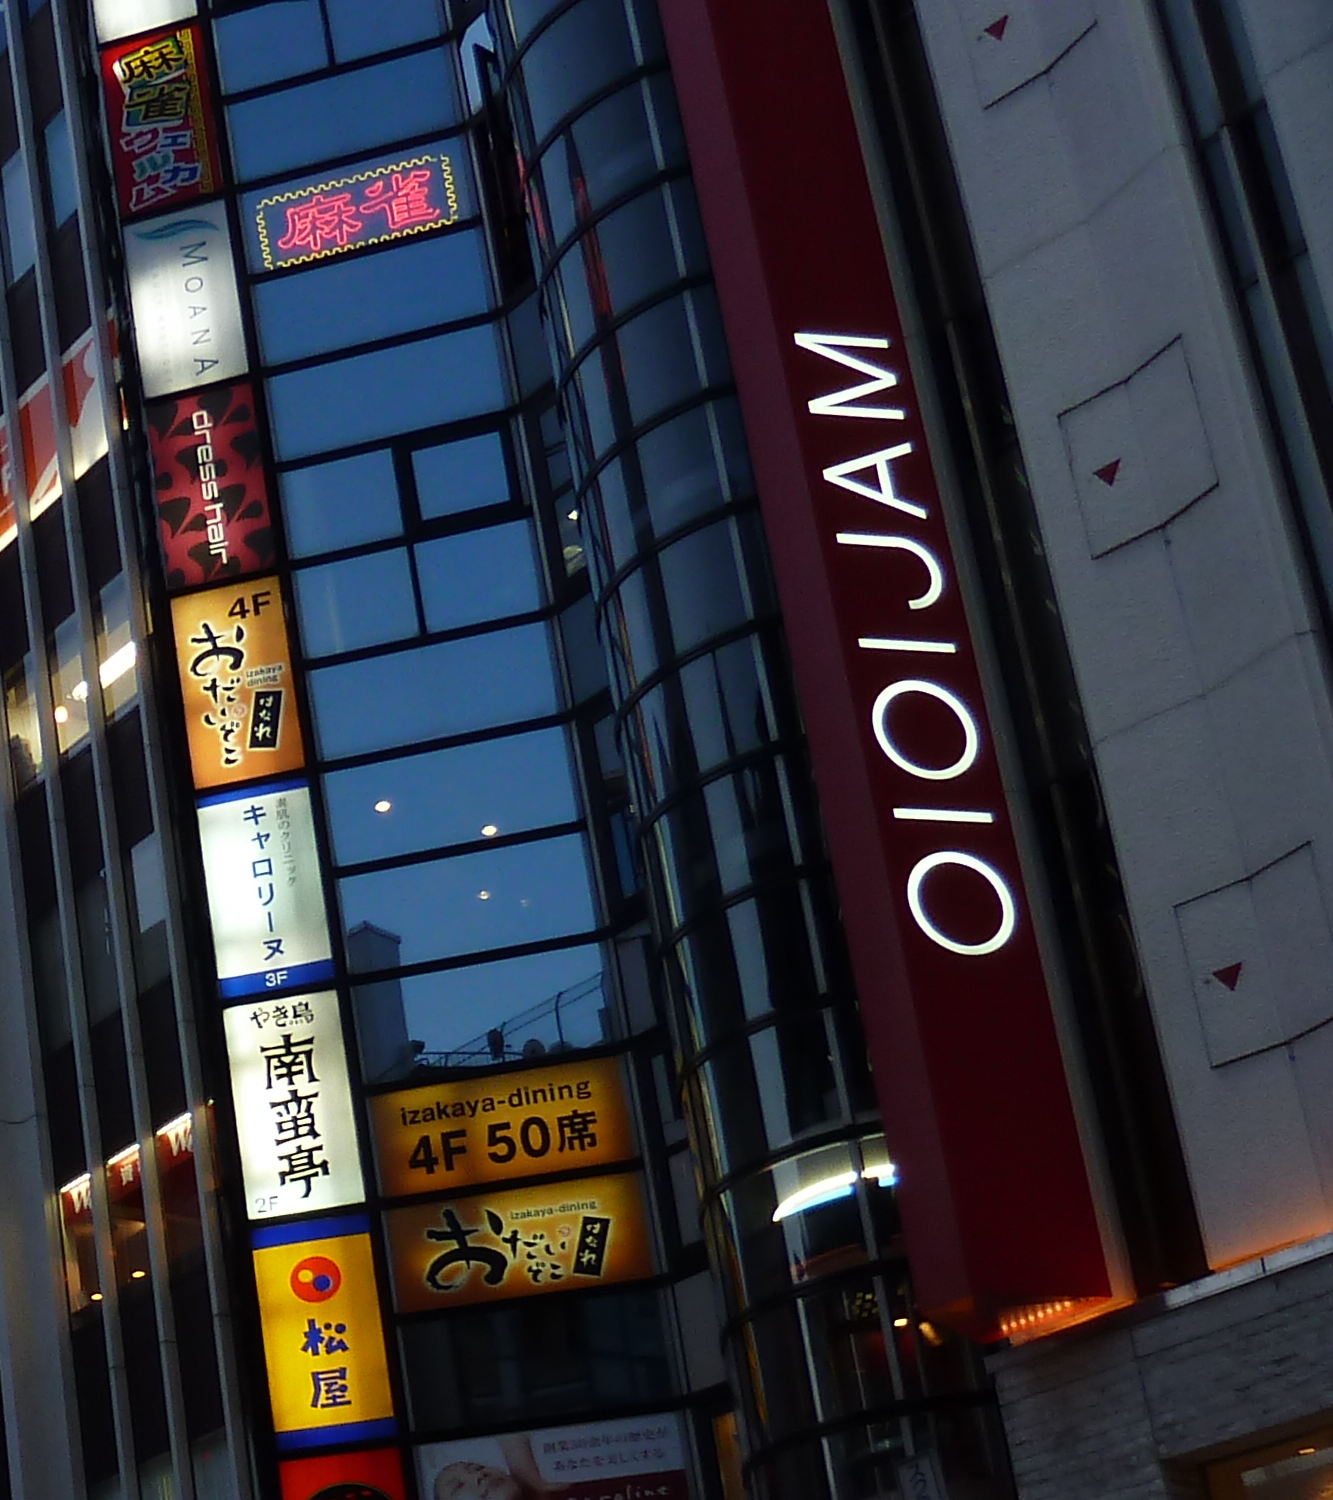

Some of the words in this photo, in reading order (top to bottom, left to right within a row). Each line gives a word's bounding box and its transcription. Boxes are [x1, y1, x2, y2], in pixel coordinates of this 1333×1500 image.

[121, 44, 189, 122] 麻雀
[277, 168, 441, 252] 麻雀
[179, 240, 220, 378] MOANA
[793, 331, 943, 611] JAM
[227, 591, 272, 620] 4F
[245, 674, 279, 687] dining
[242, 804, 287, 961] キャロリーヌ
[264, 970, 289, 989] 3F
[258, 1033, 331, 1200] 南蛮亭
[399, 1079, 593, 1127] izakaya-dining
[407, 1129, 468, 1178] 4F
[485, 1110, 599, 1158] 50席
[303, 1318, 353, 1409] 松屋
